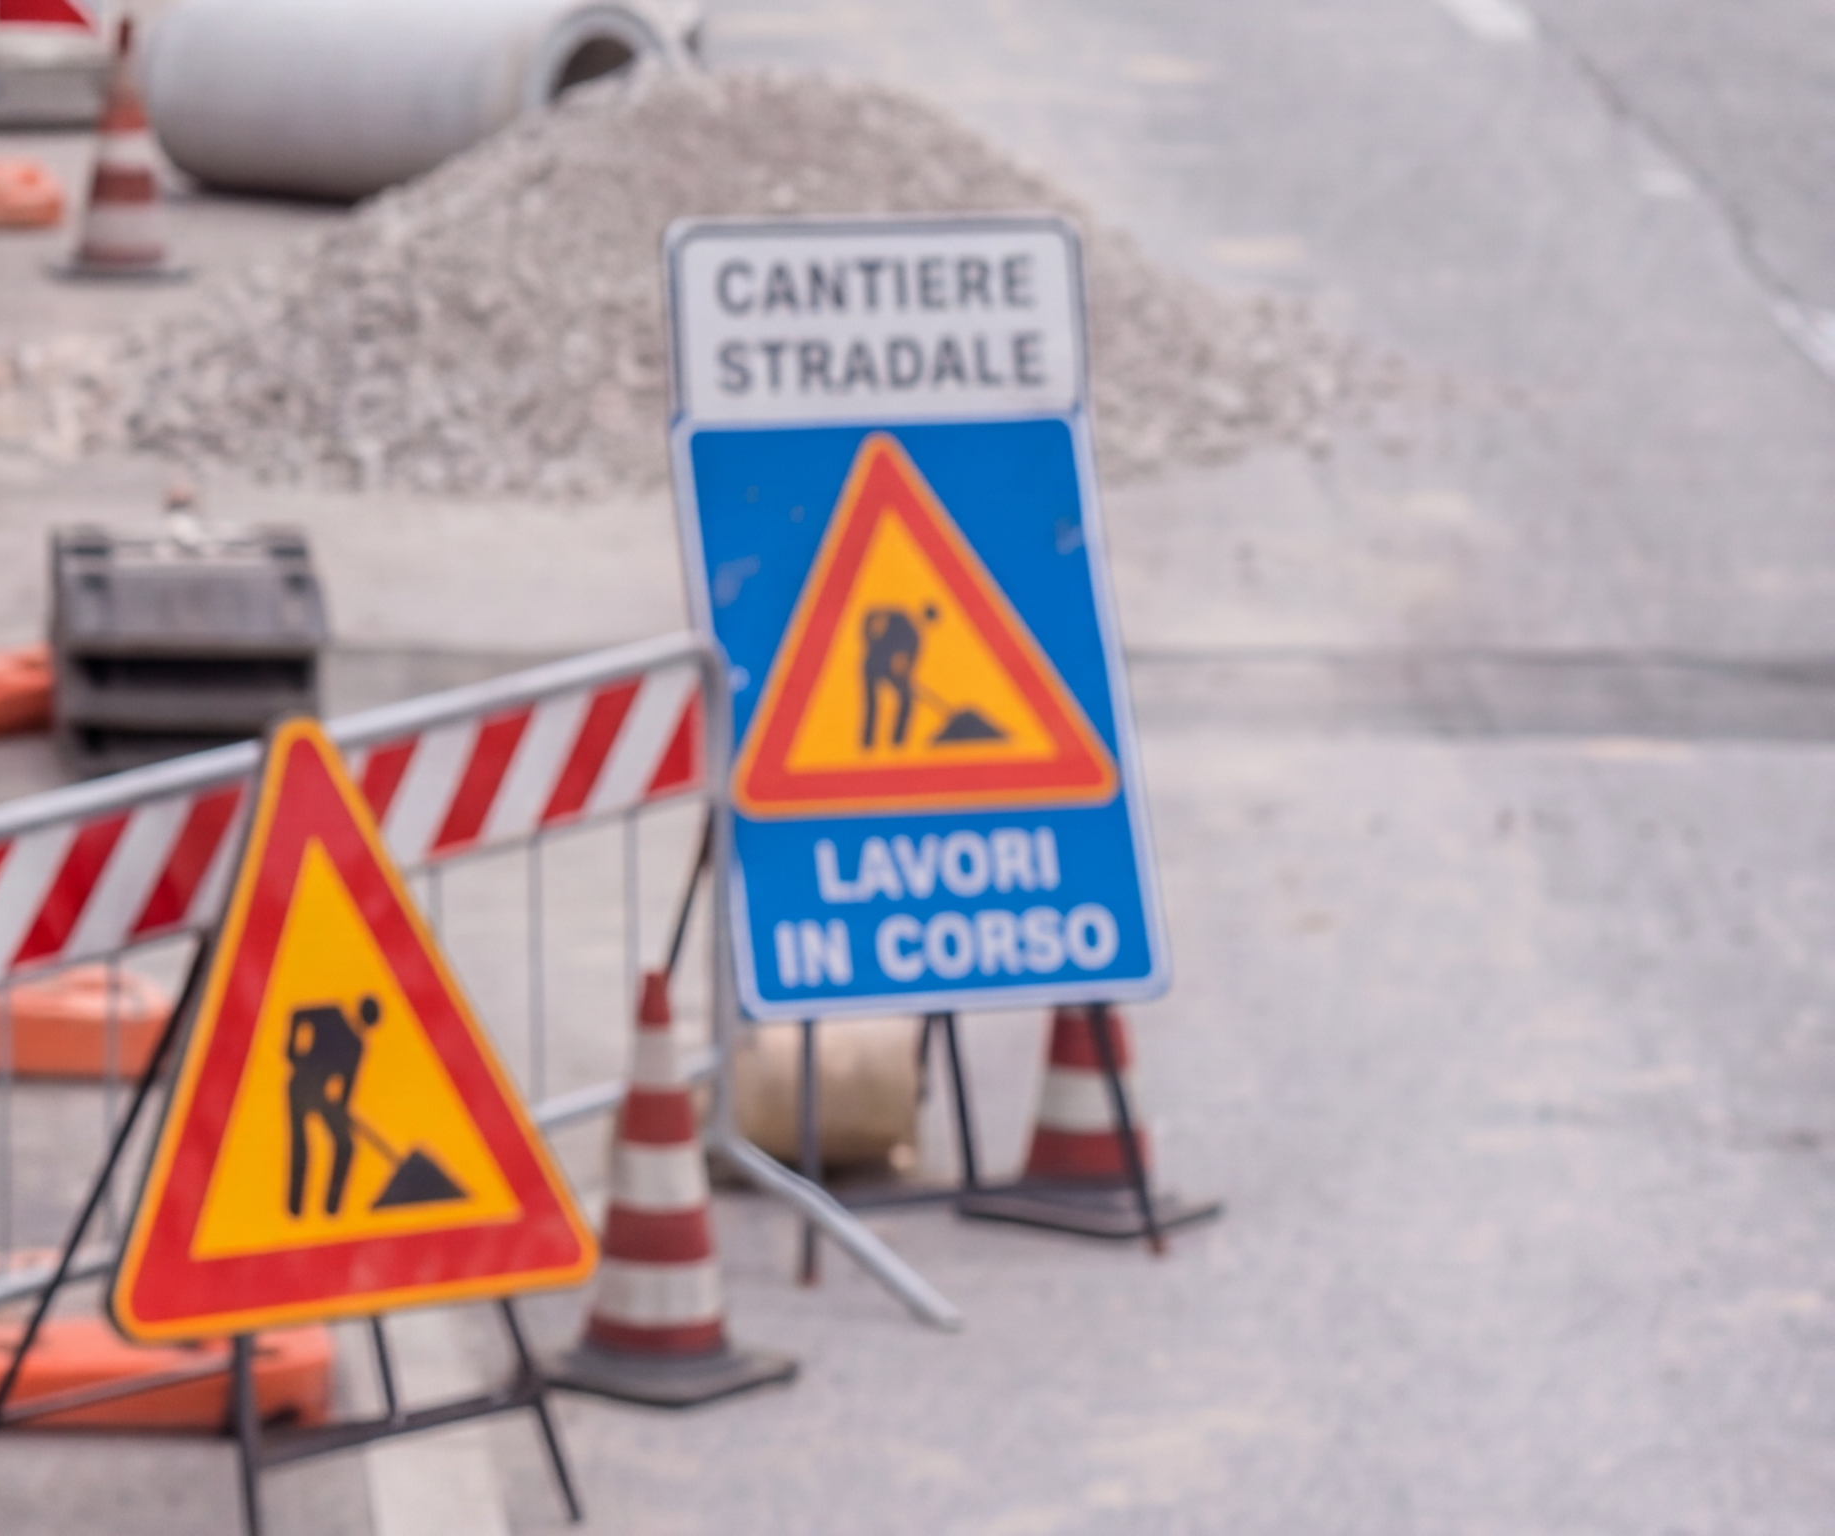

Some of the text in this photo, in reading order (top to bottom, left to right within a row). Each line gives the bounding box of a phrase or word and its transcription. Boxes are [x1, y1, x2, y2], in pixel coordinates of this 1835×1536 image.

[714, 252, 1038, 316] CANTIERE
[715, 331, 1048, 397] STRADALE
[814, 826, 1061, 903] LAVORI
[774, 902, 1121, 987] IN CORSO
